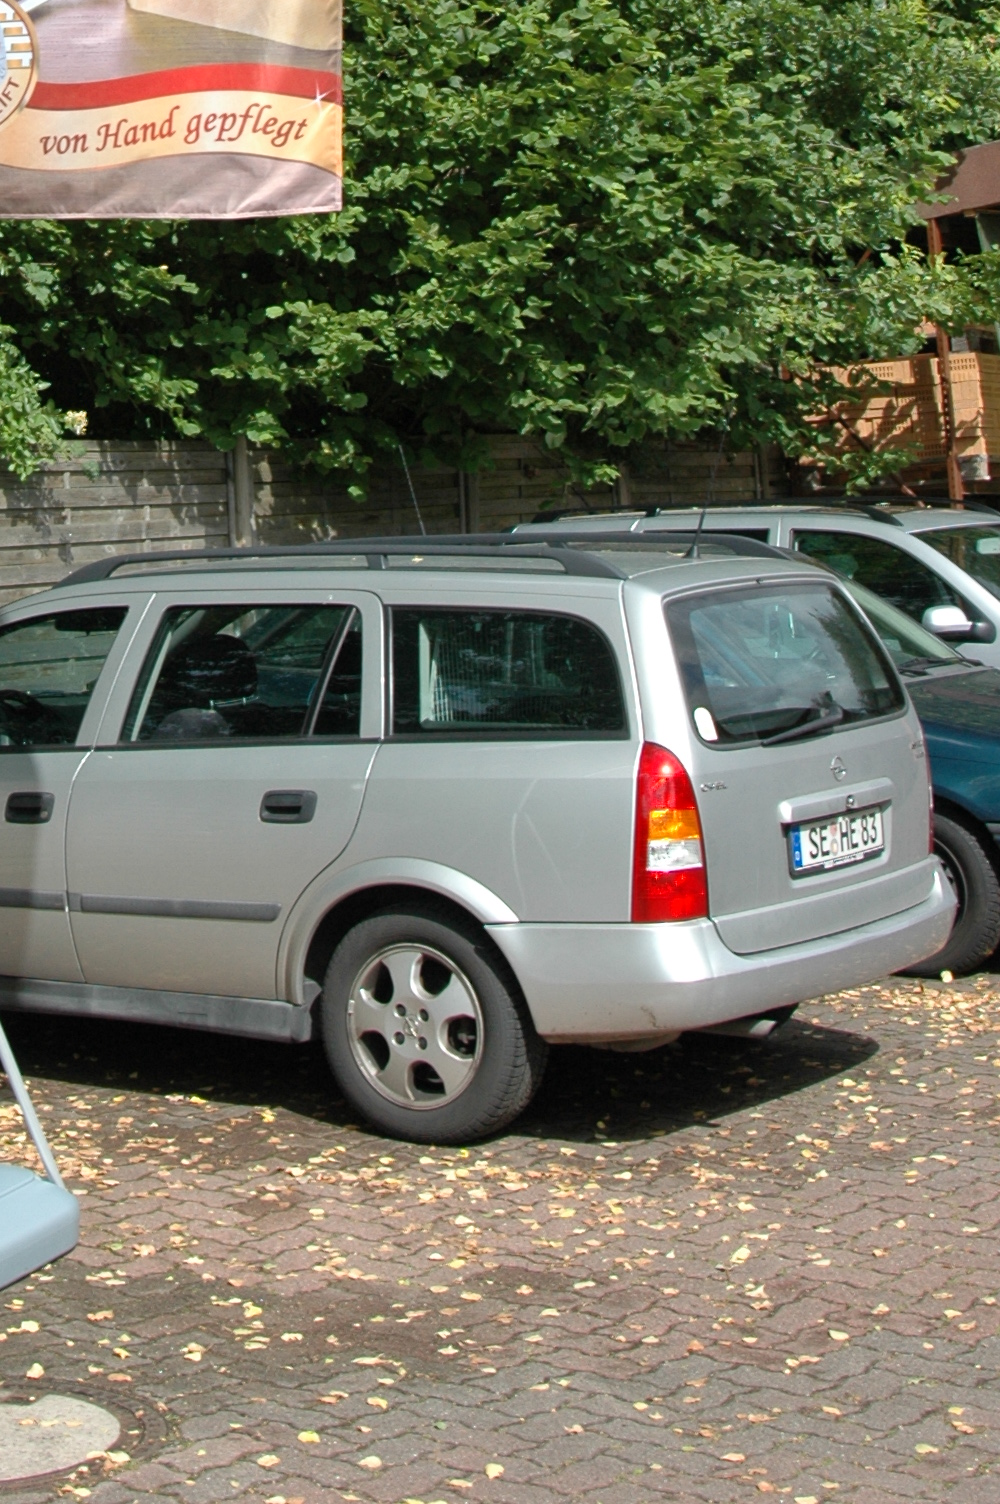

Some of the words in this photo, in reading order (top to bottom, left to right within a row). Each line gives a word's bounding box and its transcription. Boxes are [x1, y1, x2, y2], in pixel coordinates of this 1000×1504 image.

[40, 133, 88, 156] von
[96, 105, 181, 152] Hand
[184, 102, 309, 145] gepflegt
[808, 824, 831, 860] SE
[861, 811, 878, 847] 83
